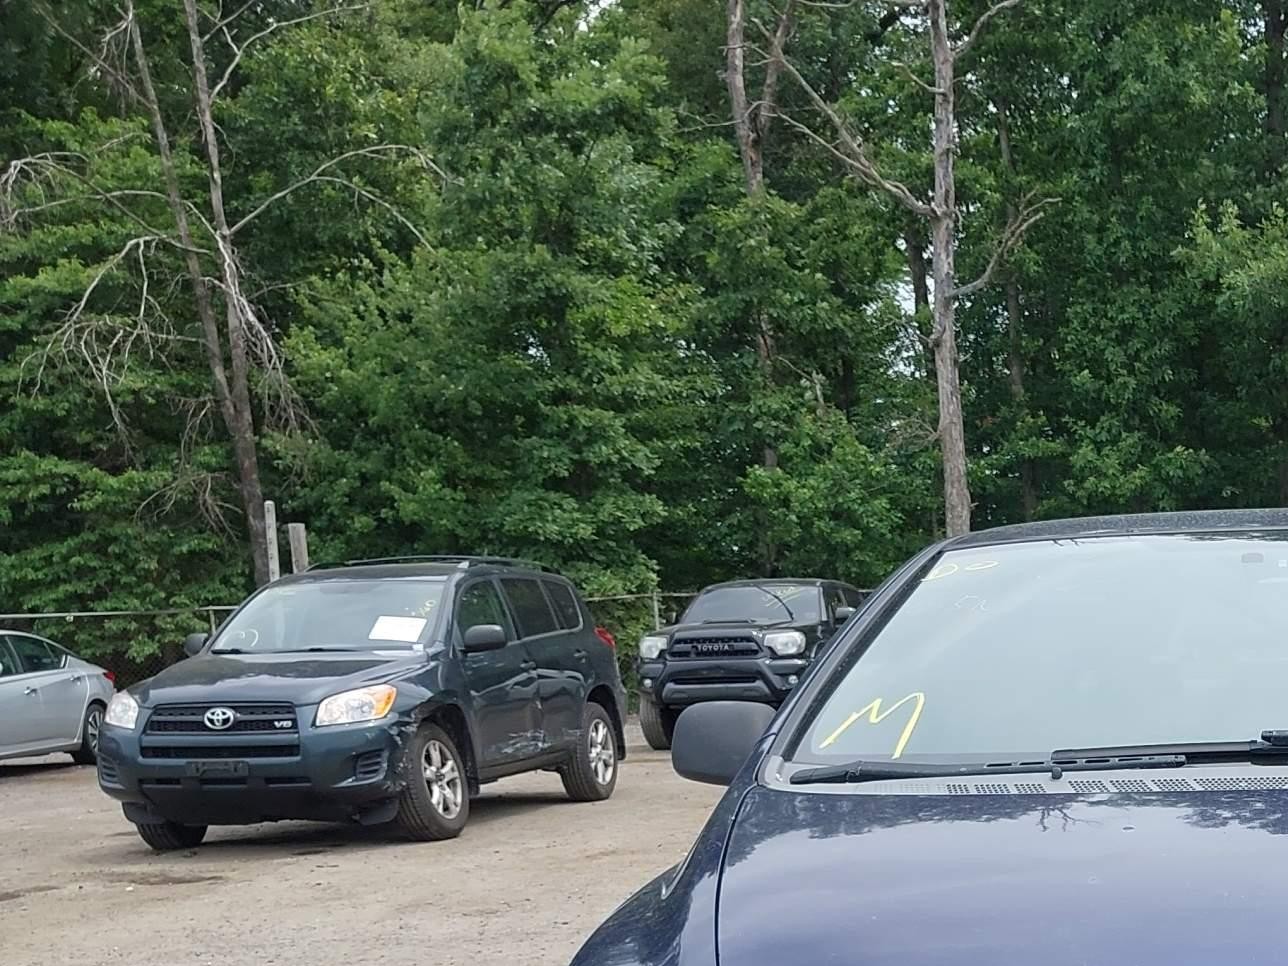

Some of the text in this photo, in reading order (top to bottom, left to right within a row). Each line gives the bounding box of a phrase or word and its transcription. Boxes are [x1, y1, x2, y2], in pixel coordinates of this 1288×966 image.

[697, 644, 730, 652] TOYOTA
[273, 720, 293, 729] V6
[818, 691, 926, 760] M
